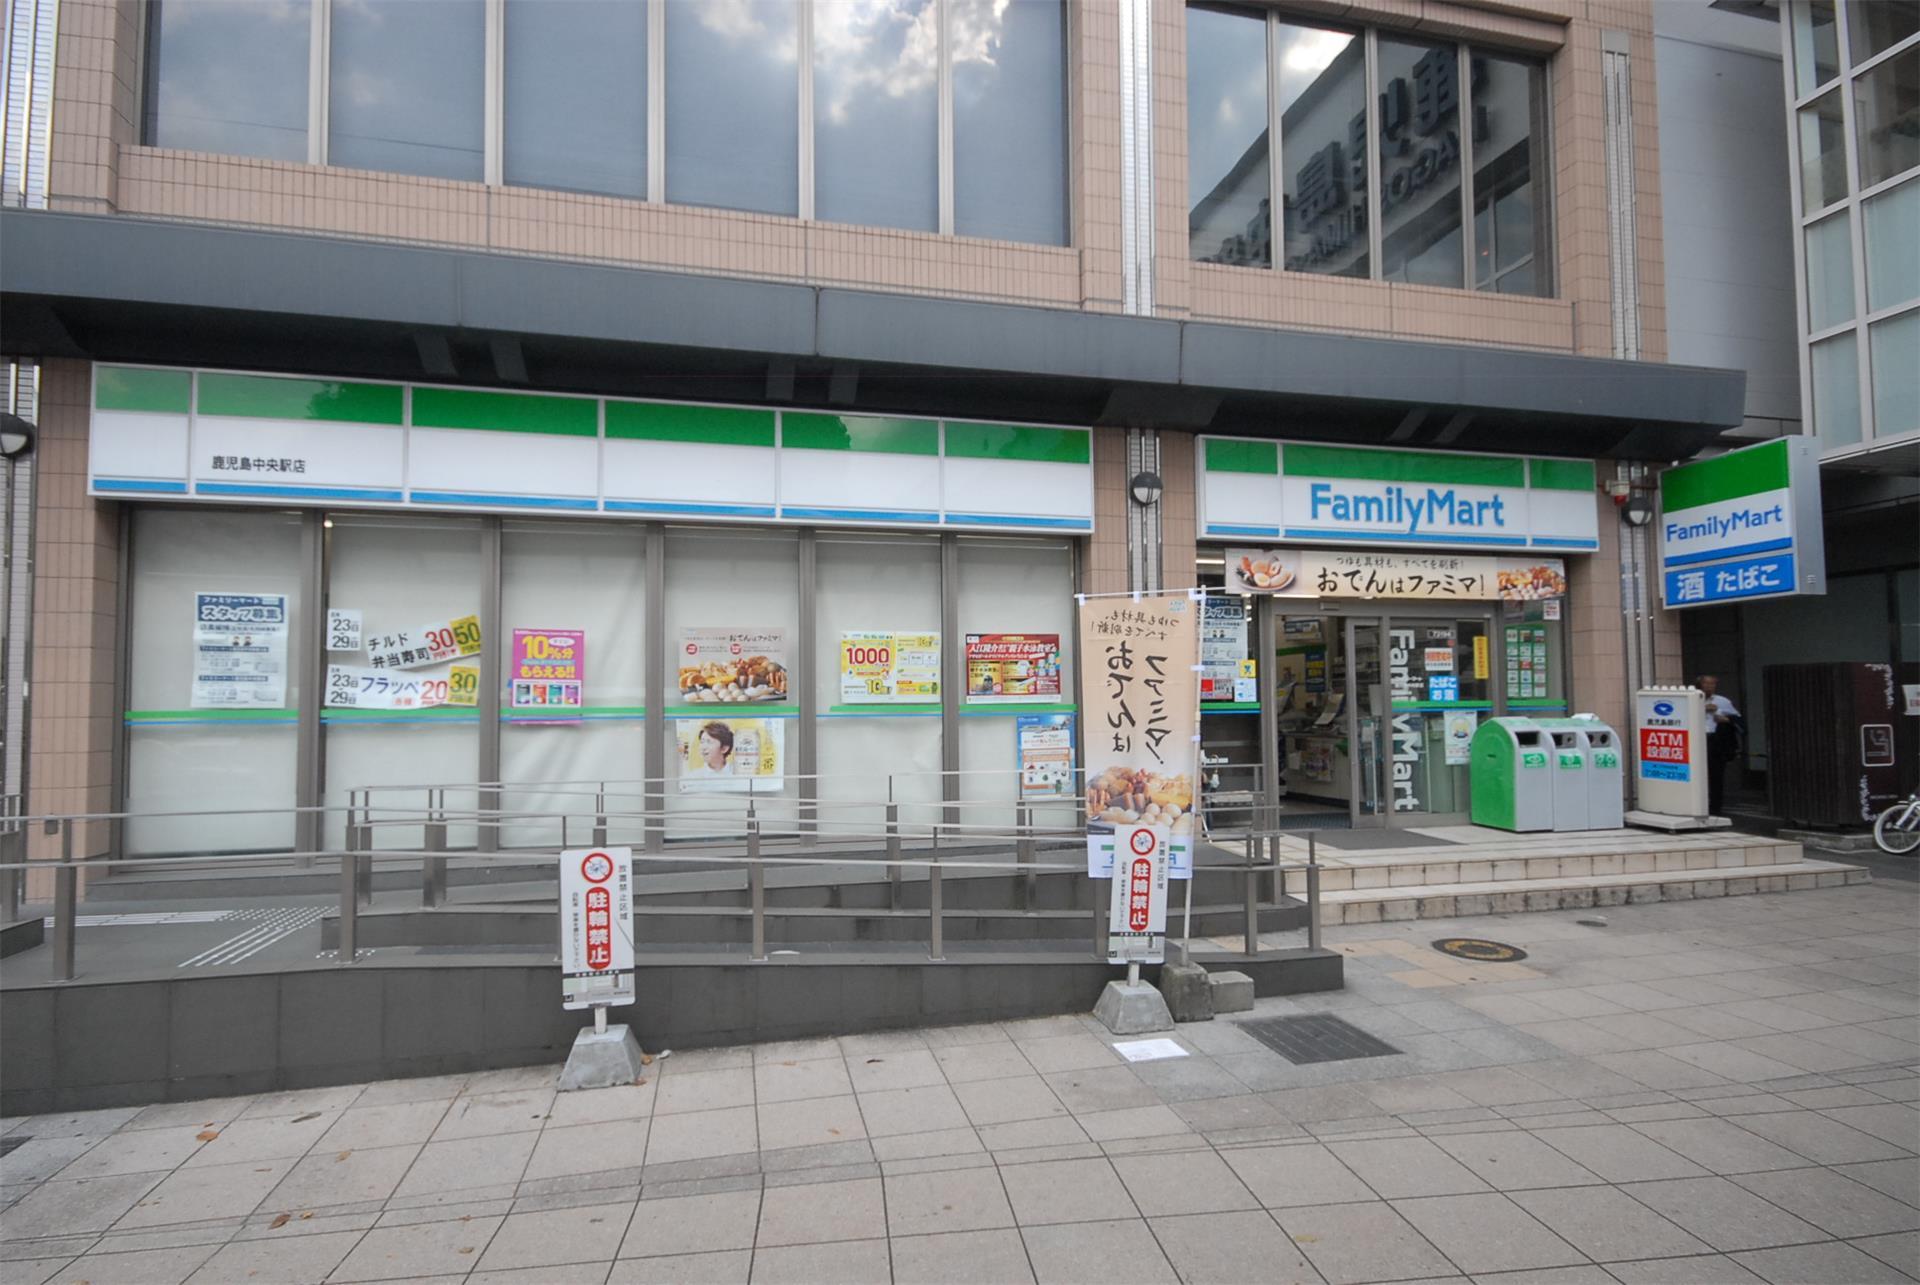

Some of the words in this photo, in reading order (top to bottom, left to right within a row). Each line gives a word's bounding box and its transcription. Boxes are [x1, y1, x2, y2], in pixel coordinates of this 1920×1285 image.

[212, 456, 305, 473] 鹿児島中央駅店
[1311, 483, 1504, 534] FamilyMart
[1666, 504, 1782, 542] FamilyMart
[1318, 567, 1484, 596] おでんはファミマ！
[1677, 571, 1704, 600] 酒
[1716, 563, 1780, 592] たばこ
[202, 606, 281, 621] スタッフ募集
[368, 633, 409, 651] チルド
[425, 628, 454, 652] 30
[371, 647, 430, 669] 弁当寿司
[420, 680, 448, 700] 20
[450, 672, 476, 693] 30
[1647, 732, 1683, 747] ATM
